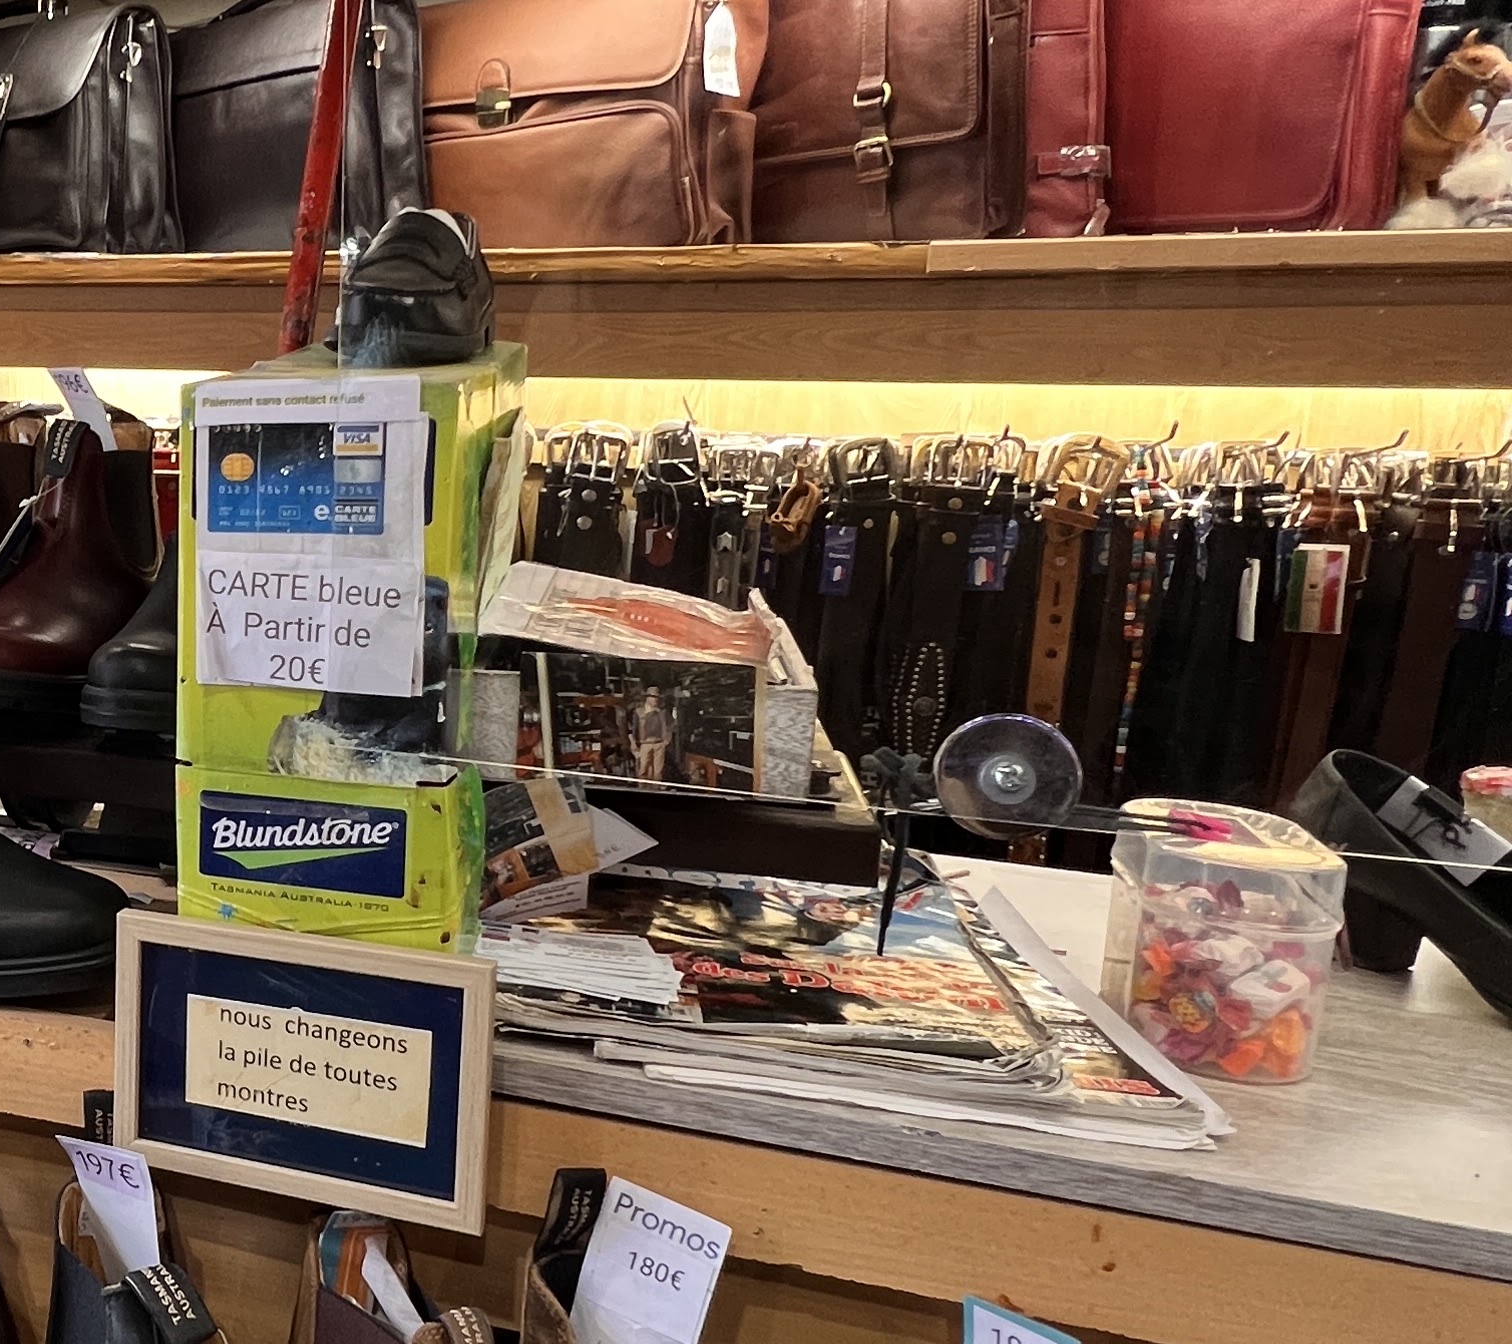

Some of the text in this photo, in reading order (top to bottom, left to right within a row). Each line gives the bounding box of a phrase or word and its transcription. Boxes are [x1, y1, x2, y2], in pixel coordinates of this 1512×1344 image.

[254, 396, 283, 407] sans
[283, 393, 328, 406] contact
[328, 391, 366, 406] refusé
[342, 432, 372, 445] VISA
[207, 569, 402, 609] CARTE bleue
[205, 600, 372, 649] À Partir de
[268, 653, 326, 685] 20€
[211, 815, 394, 850] Blundstone
[210, 881, 391, 913] TASMANIA AUSTRALIA 1870
[219, 1005, 409, 1056] nous changeons
[217, 1039, 399, 1094] la pile de toutes
[217, 1079, 310, 1114] montres
[75, 1149, 140, 1189] 197€
[612, 1191, 722, 1261] Promos
[628, 1250, 686, 1292] 180€
